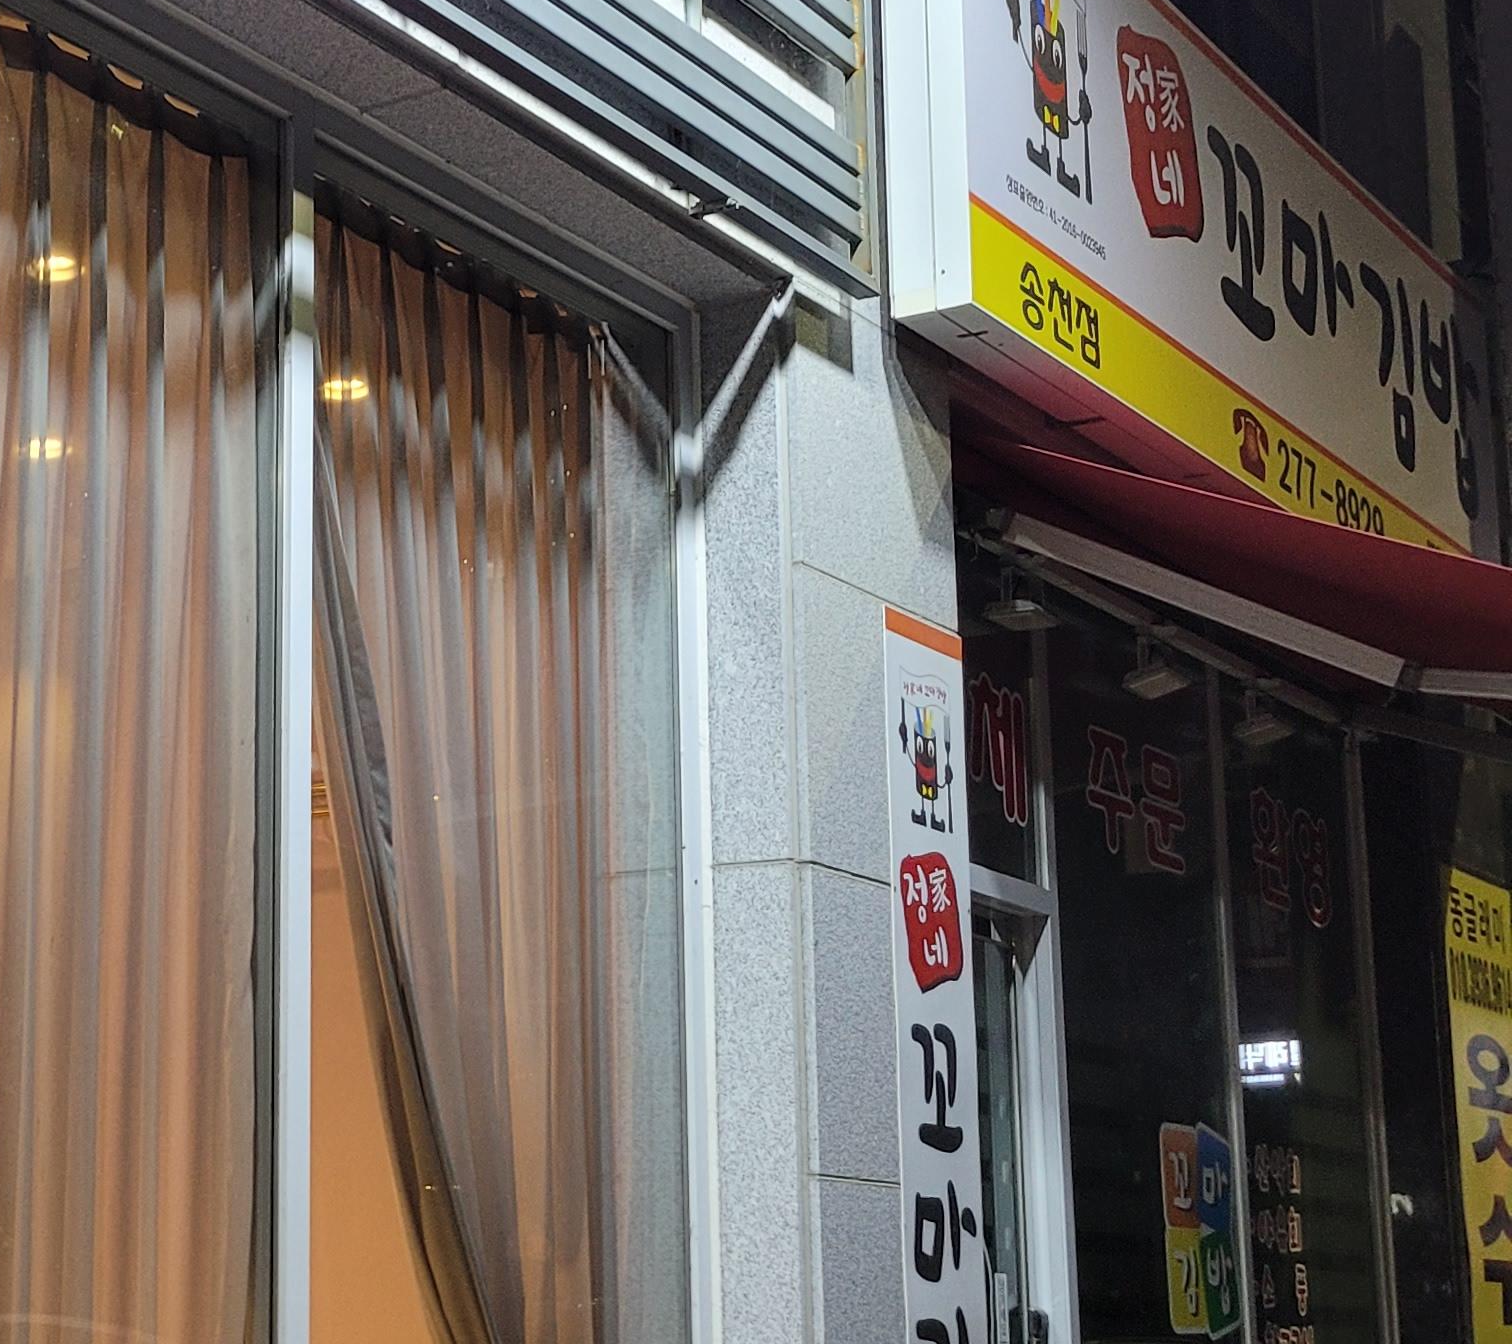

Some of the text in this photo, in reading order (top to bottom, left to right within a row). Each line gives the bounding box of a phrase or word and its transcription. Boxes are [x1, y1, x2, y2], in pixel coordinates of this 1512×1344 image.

[1019, 261, 1101, 370] 송천점
[1206, 124, 1480, 521] 꼬마김밥
[1087, 724, 1186, 875] 주문
[1248, 786, 1333, 929] 환영
